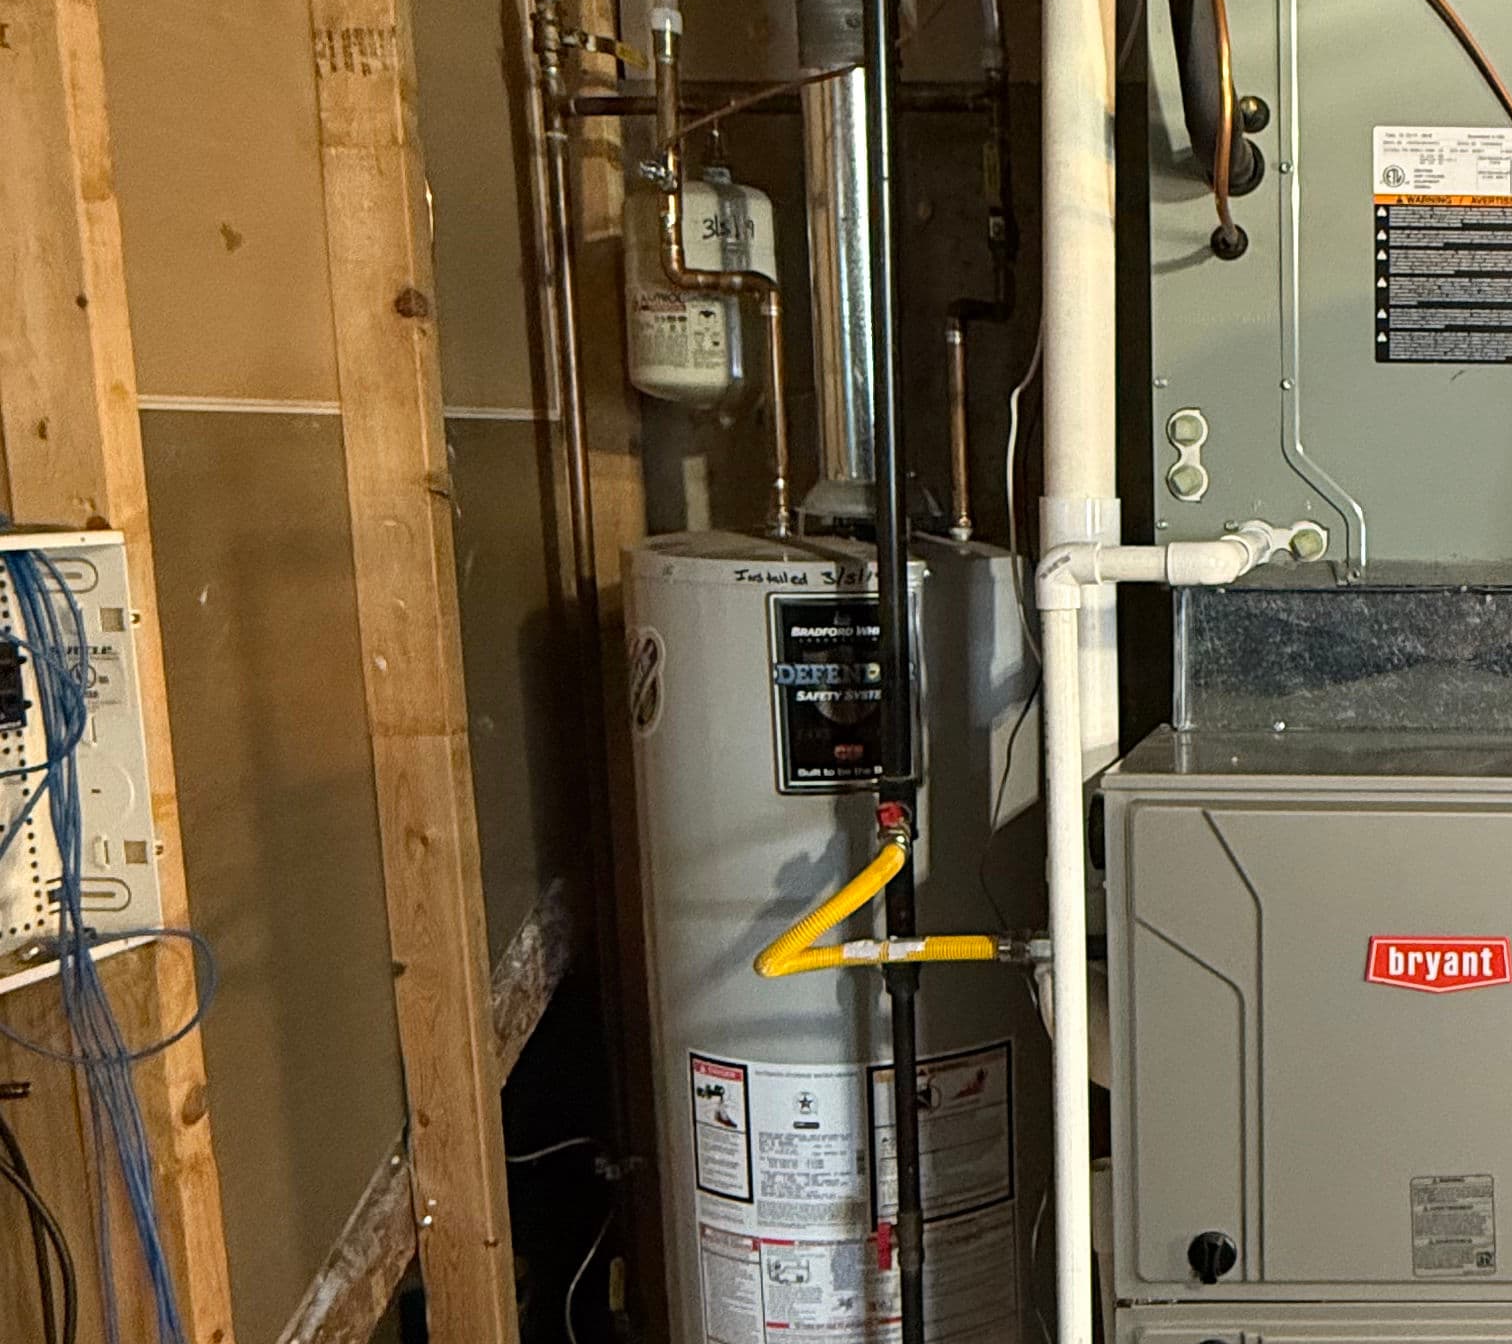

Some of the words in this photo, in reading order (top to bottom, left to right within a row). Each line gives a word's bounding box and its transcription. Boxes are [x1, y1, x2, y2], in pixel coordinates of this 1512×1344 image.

[734, 568, 808, 585] Installed
[791, 626, 853, 637] BRADFORD
[856, 626, 881, 637] WHI
[796, 690, 842, 702] SAFETY
[844, 689, 882, 701] SYSTE
[1388, 946, 1493, 981] bryant
